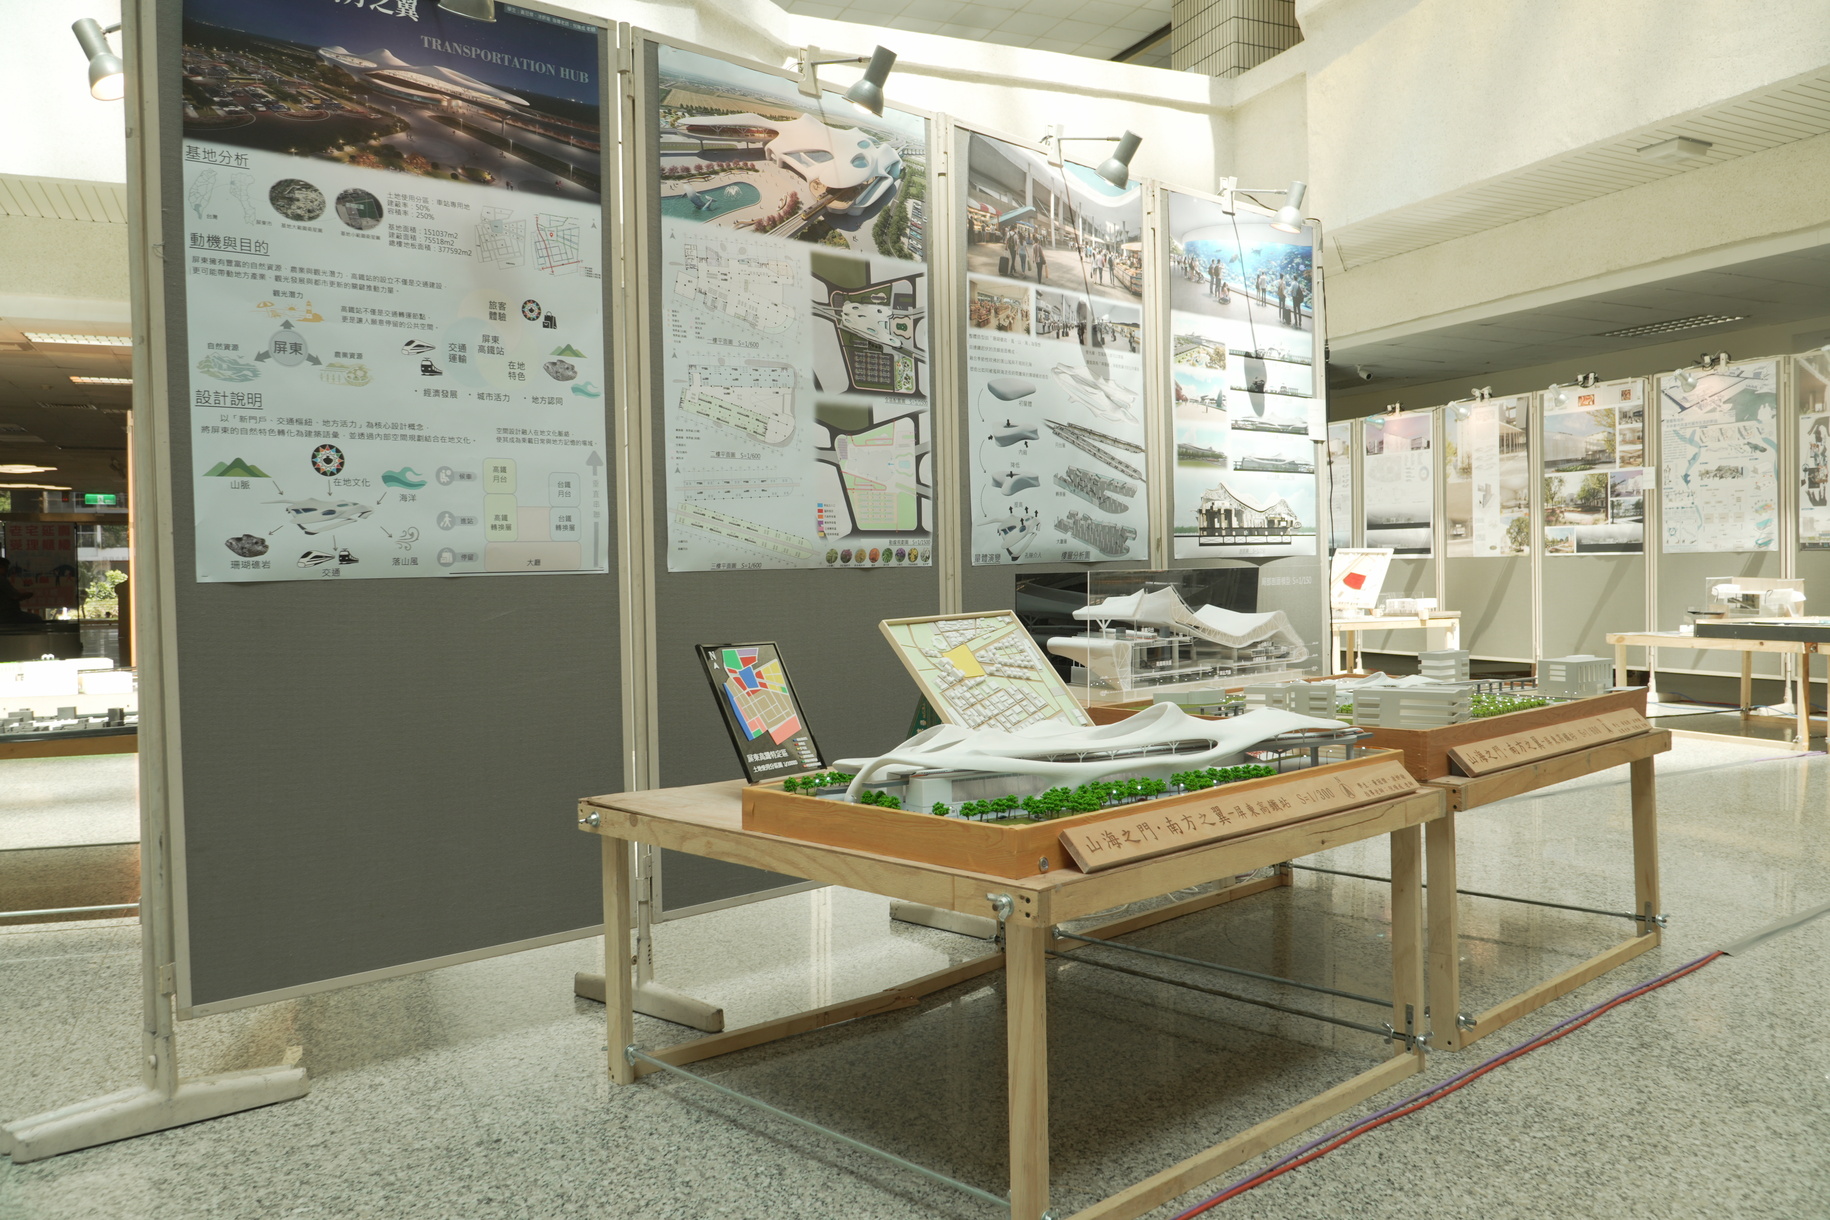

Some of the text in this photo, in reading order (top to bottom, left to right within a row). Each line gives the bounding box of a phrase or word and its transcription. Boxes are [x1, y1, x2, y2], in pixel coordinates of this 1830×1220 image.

[420, 35, 589, 84] TRANSPORTATION HUB
[185, 145, 249, 167] 基地分析
[190, 232, 270, 255] 動機與目的
[272, 289, 304, 300] 觀光潛力
[488, 301, 507, 311] 旅客
[488, 311, 507, 322] 體驗
[481, 334, 500, 344] 屏東
[207, 342, 240, 352] 自然資源
[273, 340, 304, 356] 屏東
[448, 343, 467, 353] 交通
[477, 344, 505, 356] 高鐵站
[448, 354, 467, 364] 運輸
[507, 361, 526, 371] 在地
[507, 371, 526, 381] 特色
[195, 389, 263, 408] 設計說明
[423, 388, 458, 399] 經濟發展
[476, 392, 510, 403] 城市活力
[531, 395, 564, 405] 地方認同
[333, 478, 371, 488] 在地文化
[492, 475, 508, 483] 月台
[230, 480, 251, 490] 山脈
[399, 493, 417, 502] 海洋
[557, 490, 572, 498] 月台
[230, 560, 271, 570] 珊瑚礁岩
[391, 557, 419, 567] 落山風
[526, 559, 541, 567] 大廳
[322, 568, 341, 578] 交通
[708, 651, 717, 661] N
[1296, 786, 1335, 806] S=1/300
